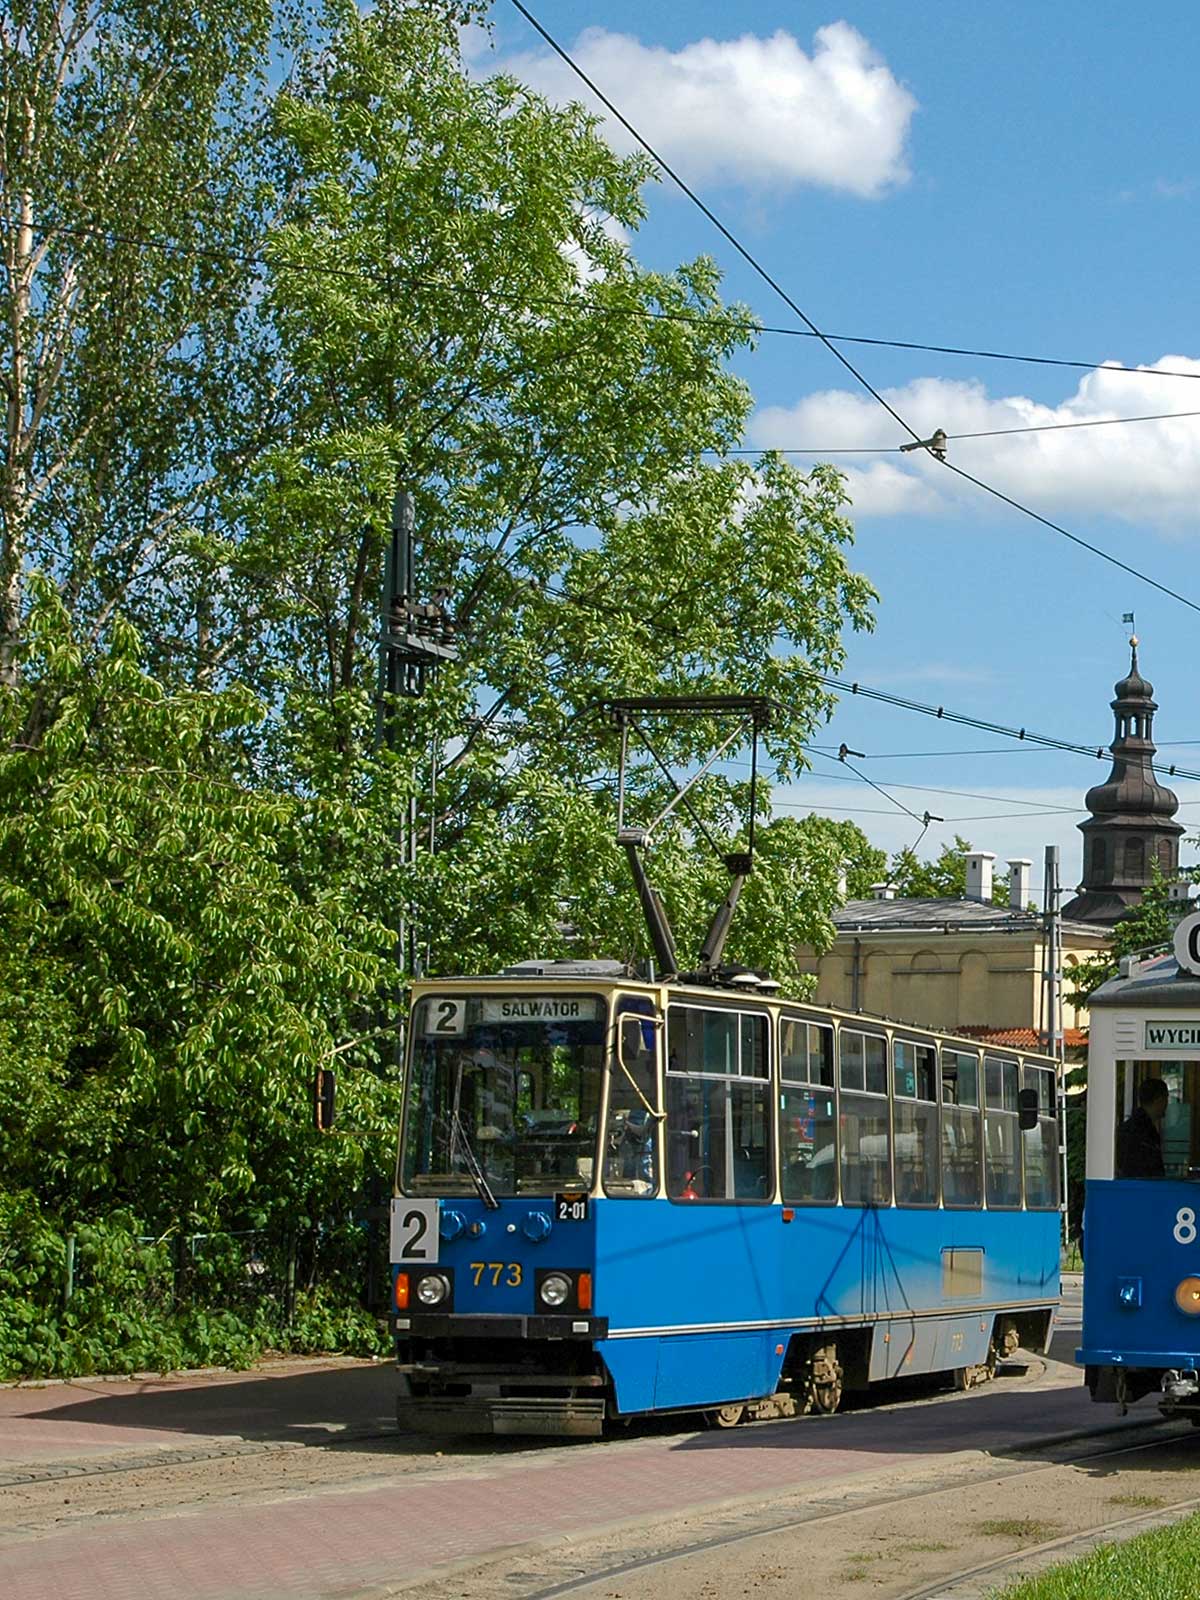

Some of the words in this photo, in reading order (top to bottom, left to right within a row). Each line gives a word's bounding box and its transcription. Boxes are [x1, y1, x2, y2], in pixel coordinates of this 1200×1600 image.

[436, 1002, 458, 1032] 2
[501, 1002, 580, 1017] SALWATOR
[401, 1210, 428, 1259] 2
[470, 1263, 523, 1287] 773
